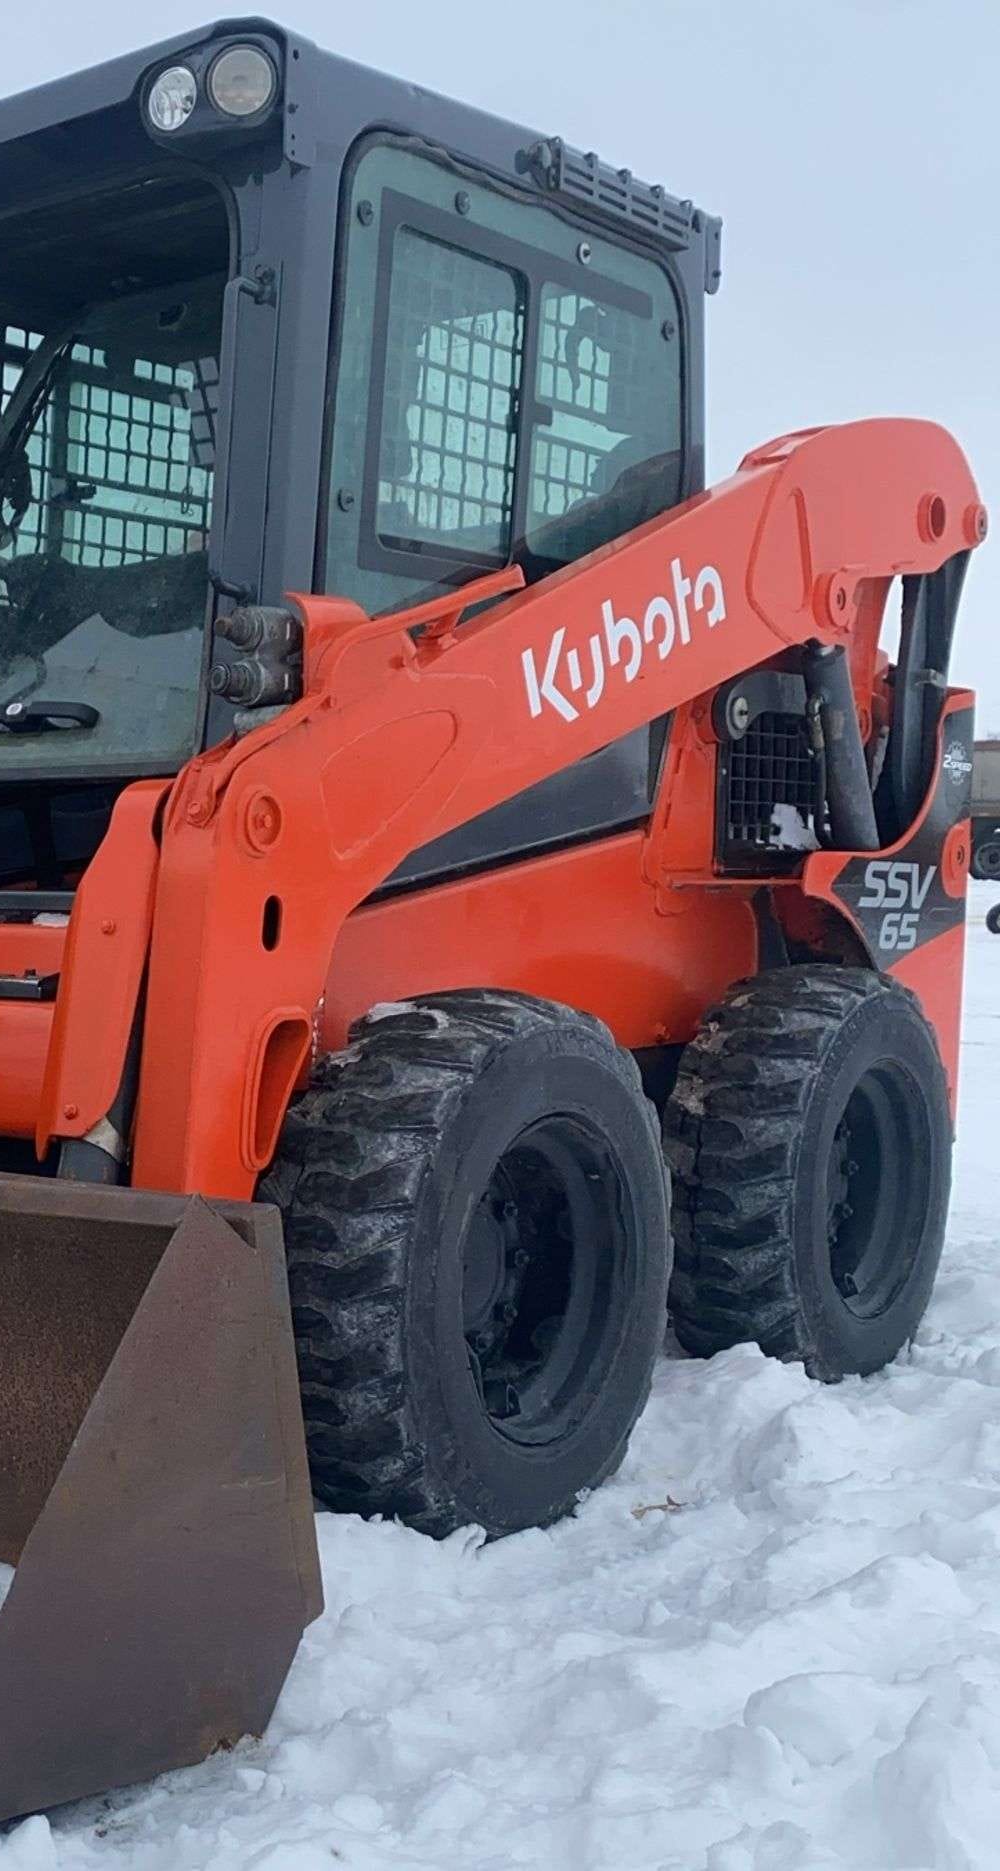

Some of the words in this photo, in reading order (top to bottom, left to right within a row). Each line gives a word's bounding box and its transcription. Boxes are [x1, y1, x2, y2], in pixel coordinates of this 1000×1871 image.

[521, 557, 726, 723] Kubota
[858, 861, 937, 909] SSV
[879, 913, 920, 950] 65
